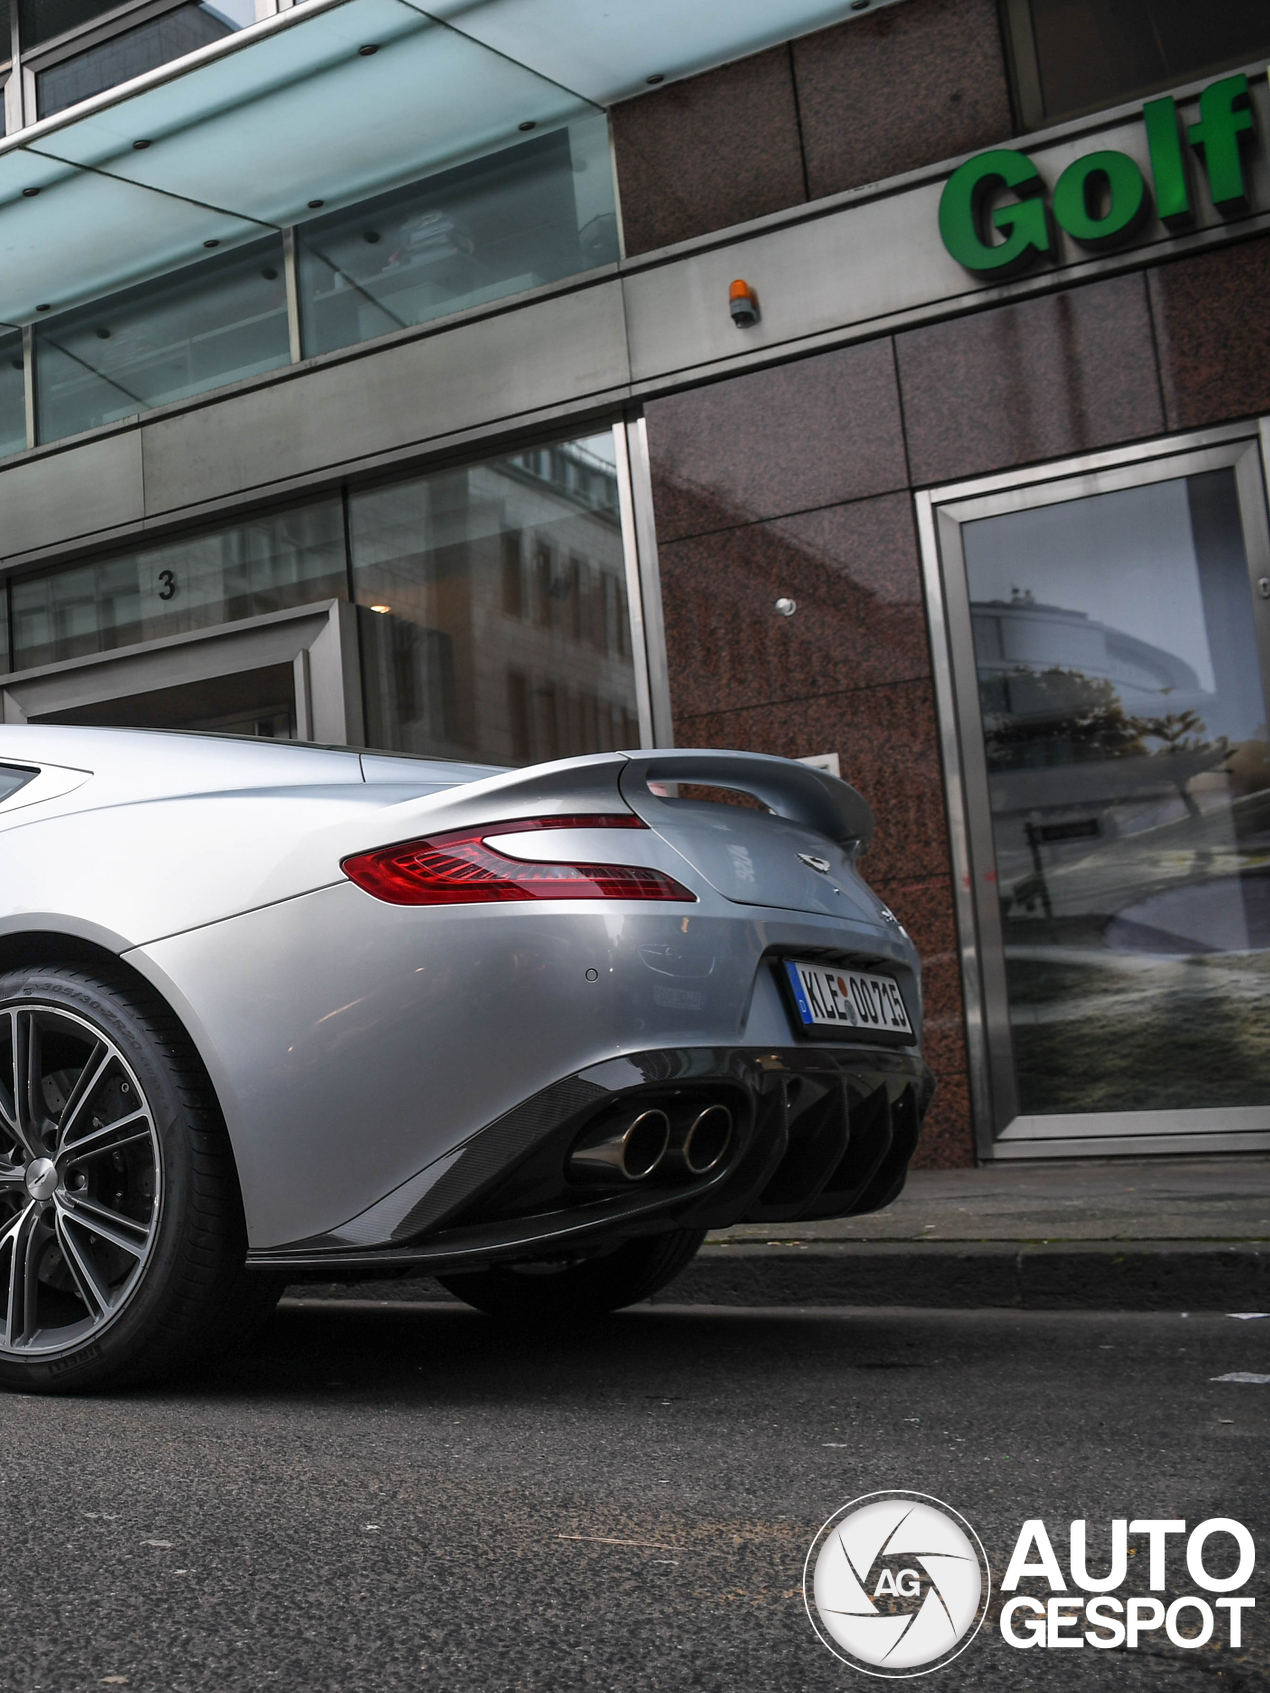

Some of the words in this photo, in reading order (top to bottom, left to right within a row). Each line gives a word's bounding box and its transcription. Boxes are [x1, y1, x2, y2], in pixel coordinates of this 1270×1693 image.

[939, 73, 1252, 272] Golf
[158, 569, 175, 600] 3
[799, 999, 807, 1013] D
[801, 971, 847, 1020] KLE
